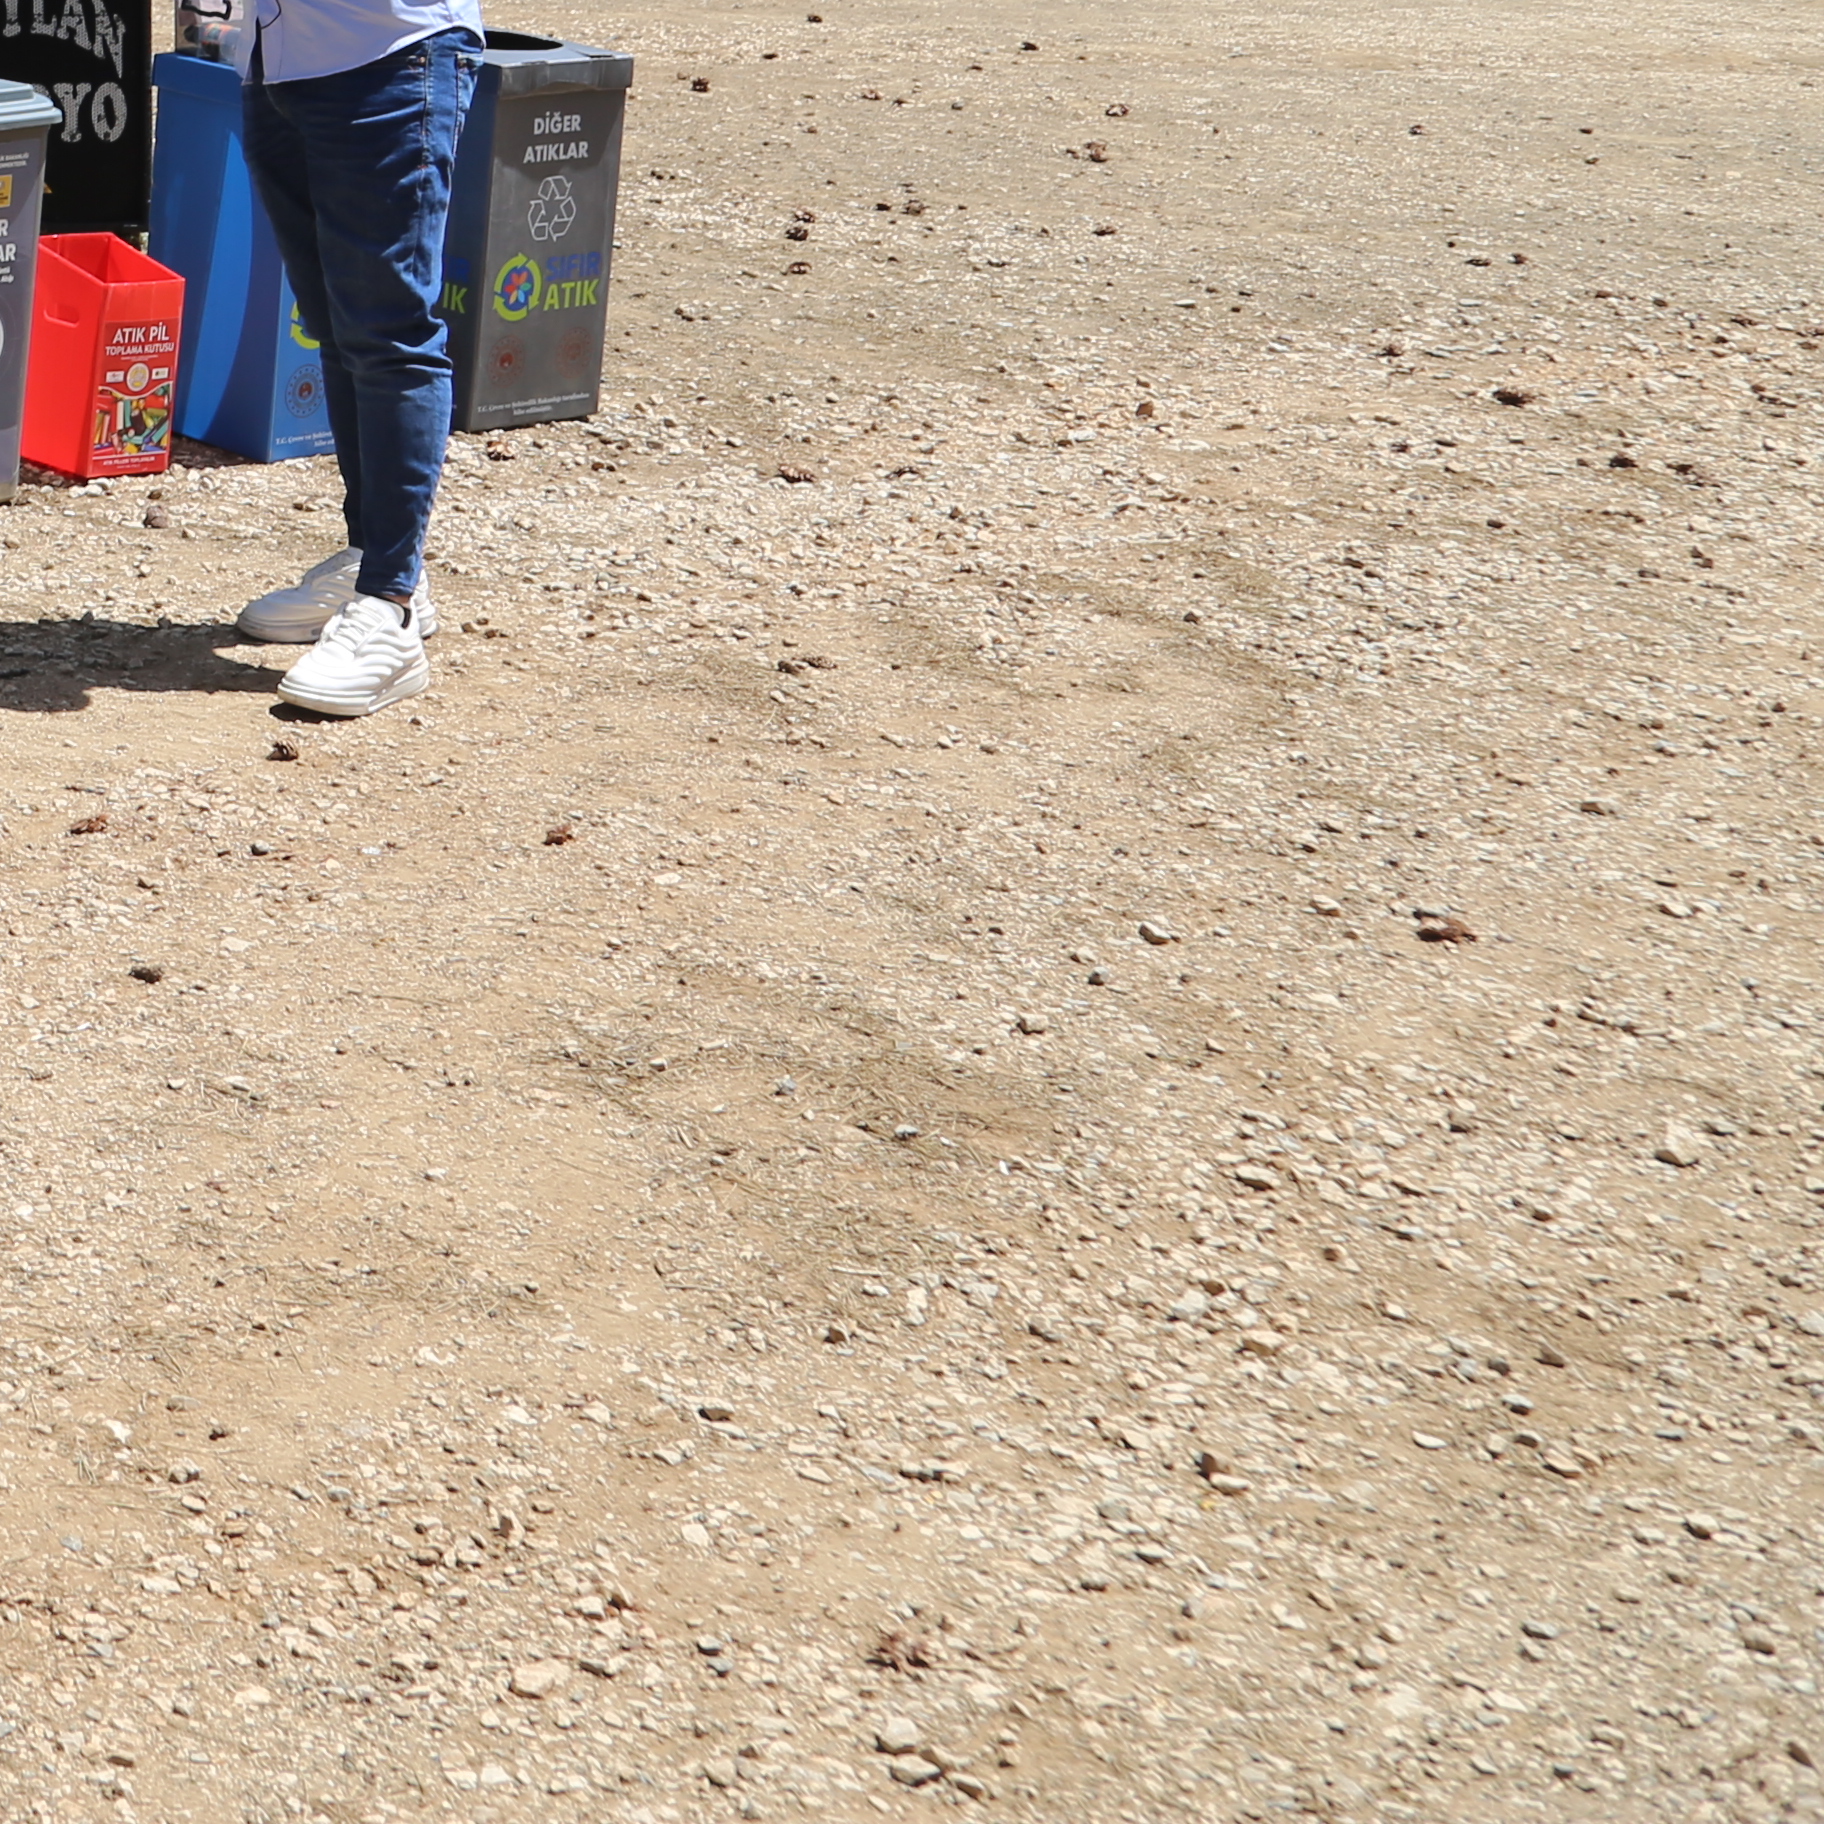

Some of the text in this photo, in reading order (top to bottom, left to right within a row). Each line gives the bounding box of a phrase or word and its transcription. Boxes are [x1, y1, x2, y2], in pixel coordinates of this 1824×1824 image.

[32, 81, 128, 143] YO
[533, 111, 581, 135] DİĞER
[523, 141, 589, 164] ATIKLAR
[545, 252, 600, 281] SIFIR
[442, 282, 468, 314] IK
[543, 279, 600, 311] ATIK
[112, 322, 170, 344] ATIK PİL
[105, 345, 143, 356] TOPLAMA
